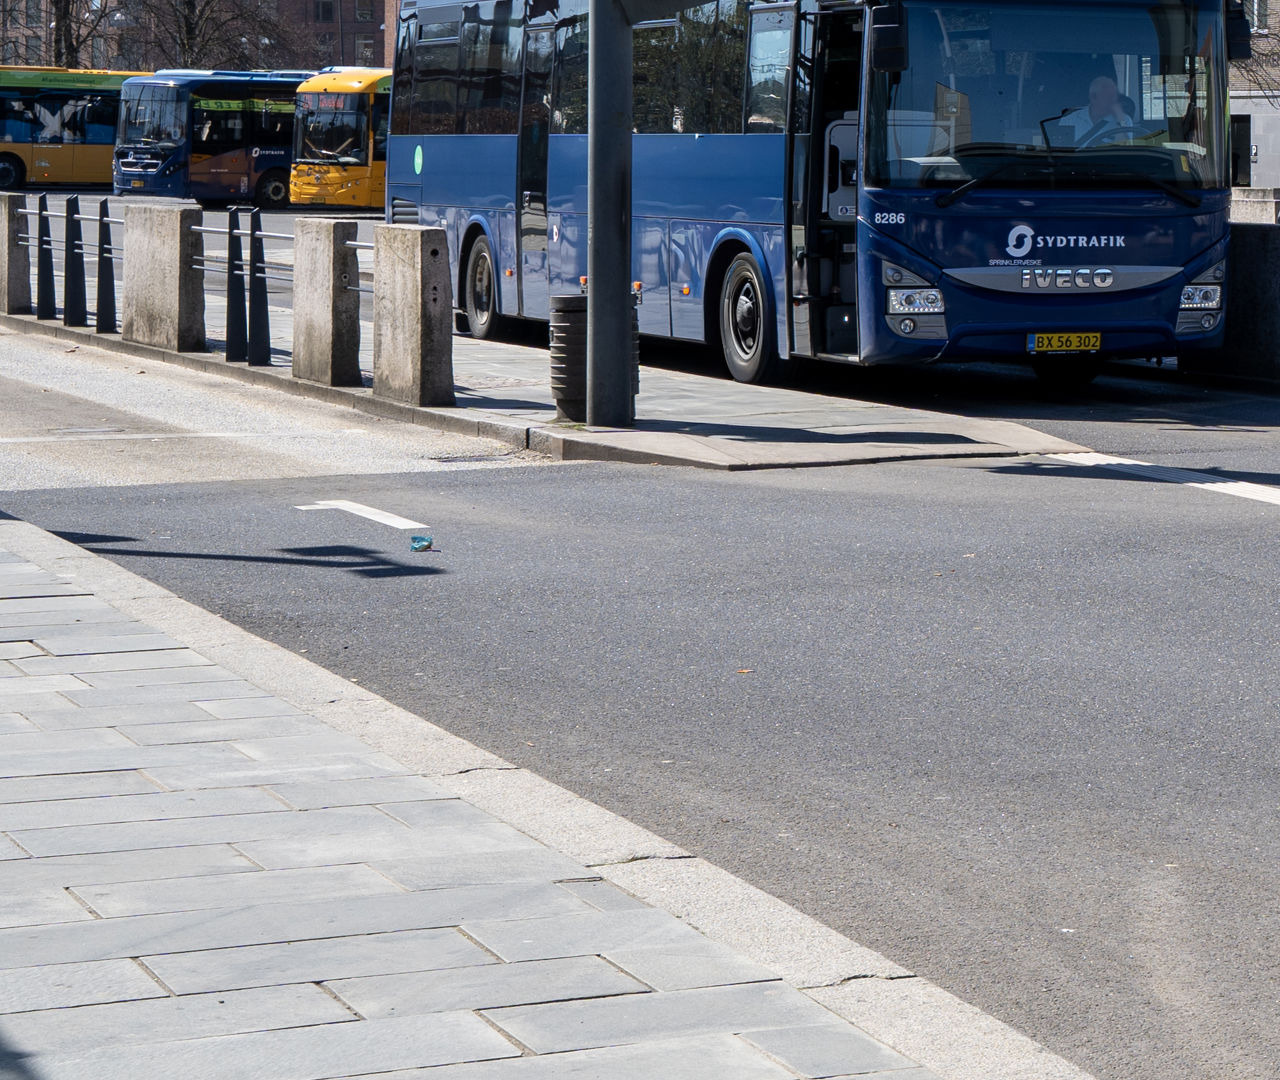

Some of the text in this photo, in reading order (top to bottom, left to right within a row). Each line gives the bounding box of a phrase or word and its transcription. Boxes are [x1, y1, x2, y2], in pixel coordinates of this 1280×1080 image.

[874, 213, 905, 224] 8286
[1036, 235, 1126, 248] SYDTRAFIK
[1021, 268, 1114, 289] IVECO
[1036, 335, 1099, 348] BX 56 302
